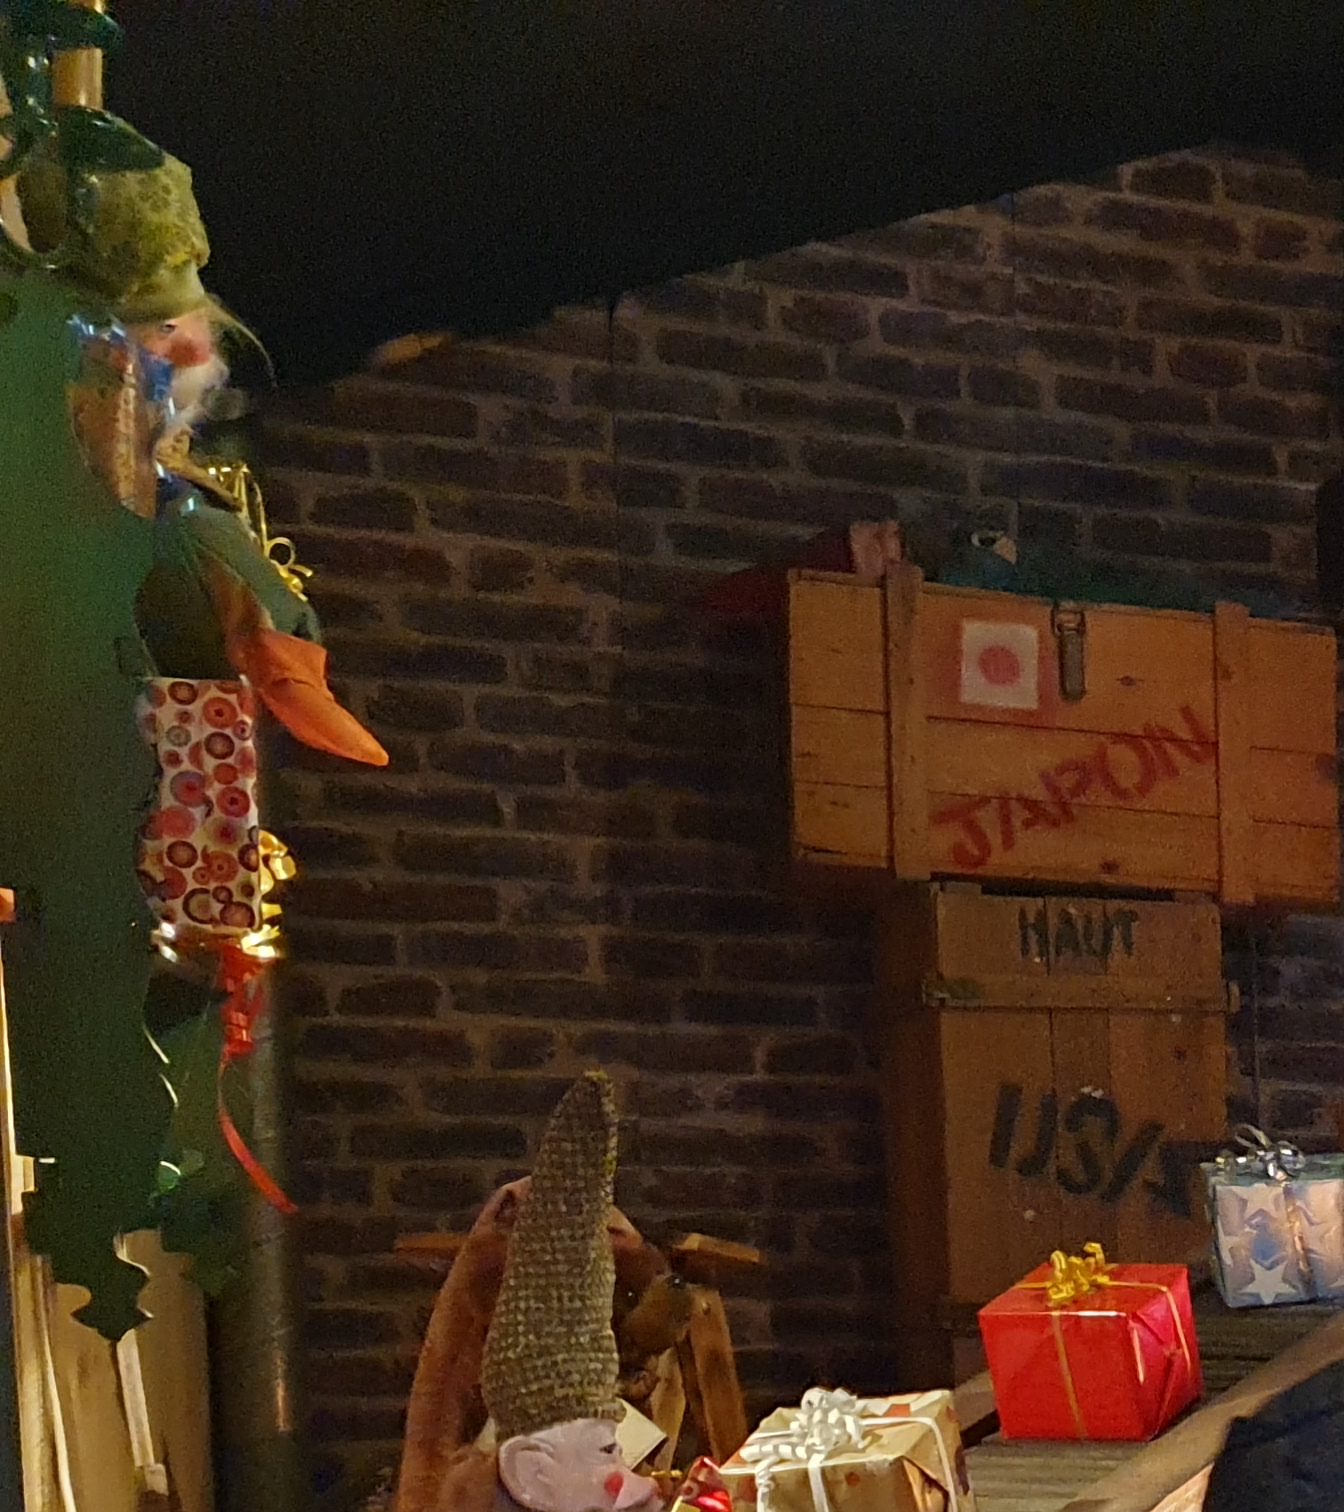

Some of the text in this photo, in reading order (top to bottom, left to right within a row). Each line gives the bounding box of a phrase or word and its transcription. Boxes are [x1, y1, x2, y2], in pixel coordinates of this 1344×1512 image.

[930, 705, 1218, 870] JAPON
[1017, 906, 1139, 958] HAUT
[988, 1082, 1193, 1219] USA
